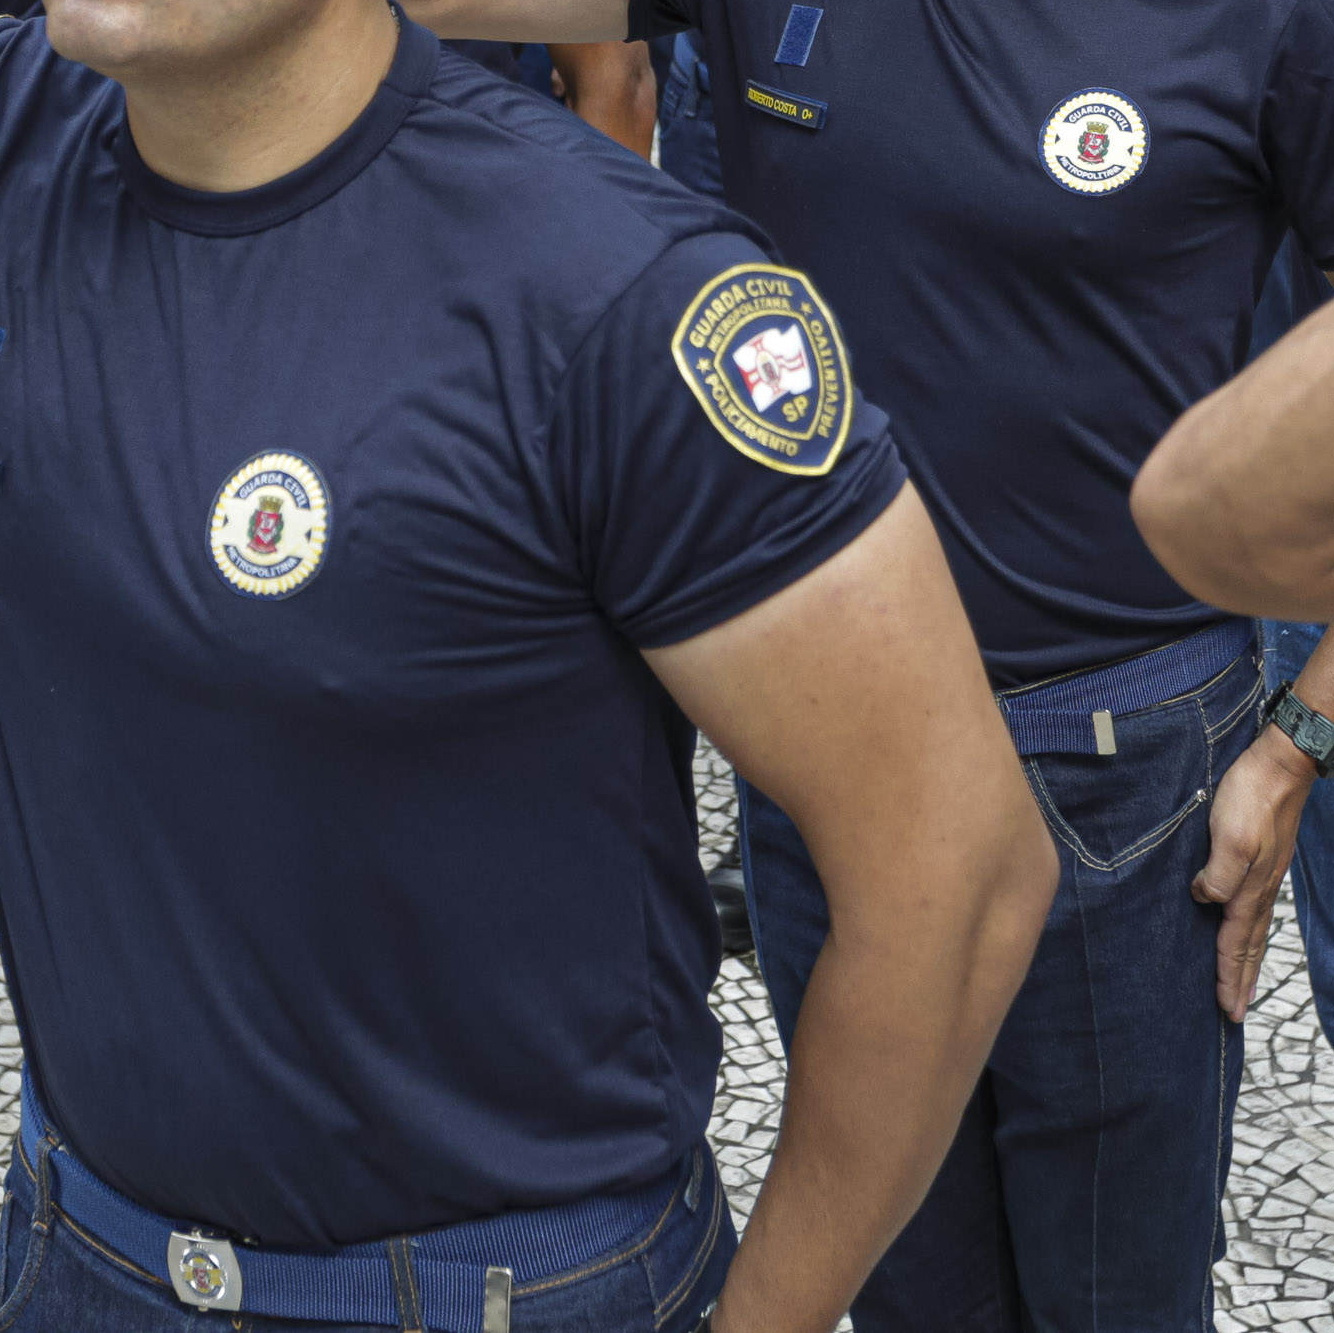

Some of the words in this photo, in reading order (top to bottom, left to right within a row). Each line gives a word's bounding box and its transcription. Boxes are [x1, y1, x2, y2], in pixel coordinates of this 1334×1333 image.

[748, 88, 773, 108] ROBERTO
[774, 100, 797, 116] COSTA
[1069, 106, 1105, 122] GUARDA
[1108, 109, 1129, 130] CIVIL
[1060, 157, 1121, 179] METROPOLITANA
[689, 284, 746, 348] GUARDA
[746, 279, 793, 296] CIVIL
[709, 297, 792, 352] METROPOLITANA
[810, 319, 840, 438] PREVENTIVO
[705, 375, 799, 457] POLICIAMENTO
[782, 395, 809, 423] SP
[239, 473, 282, 498] GUARDA
[284, 478, 307, 508] CIVIL
[227, 547, 297, 577] METROPOLITANA
